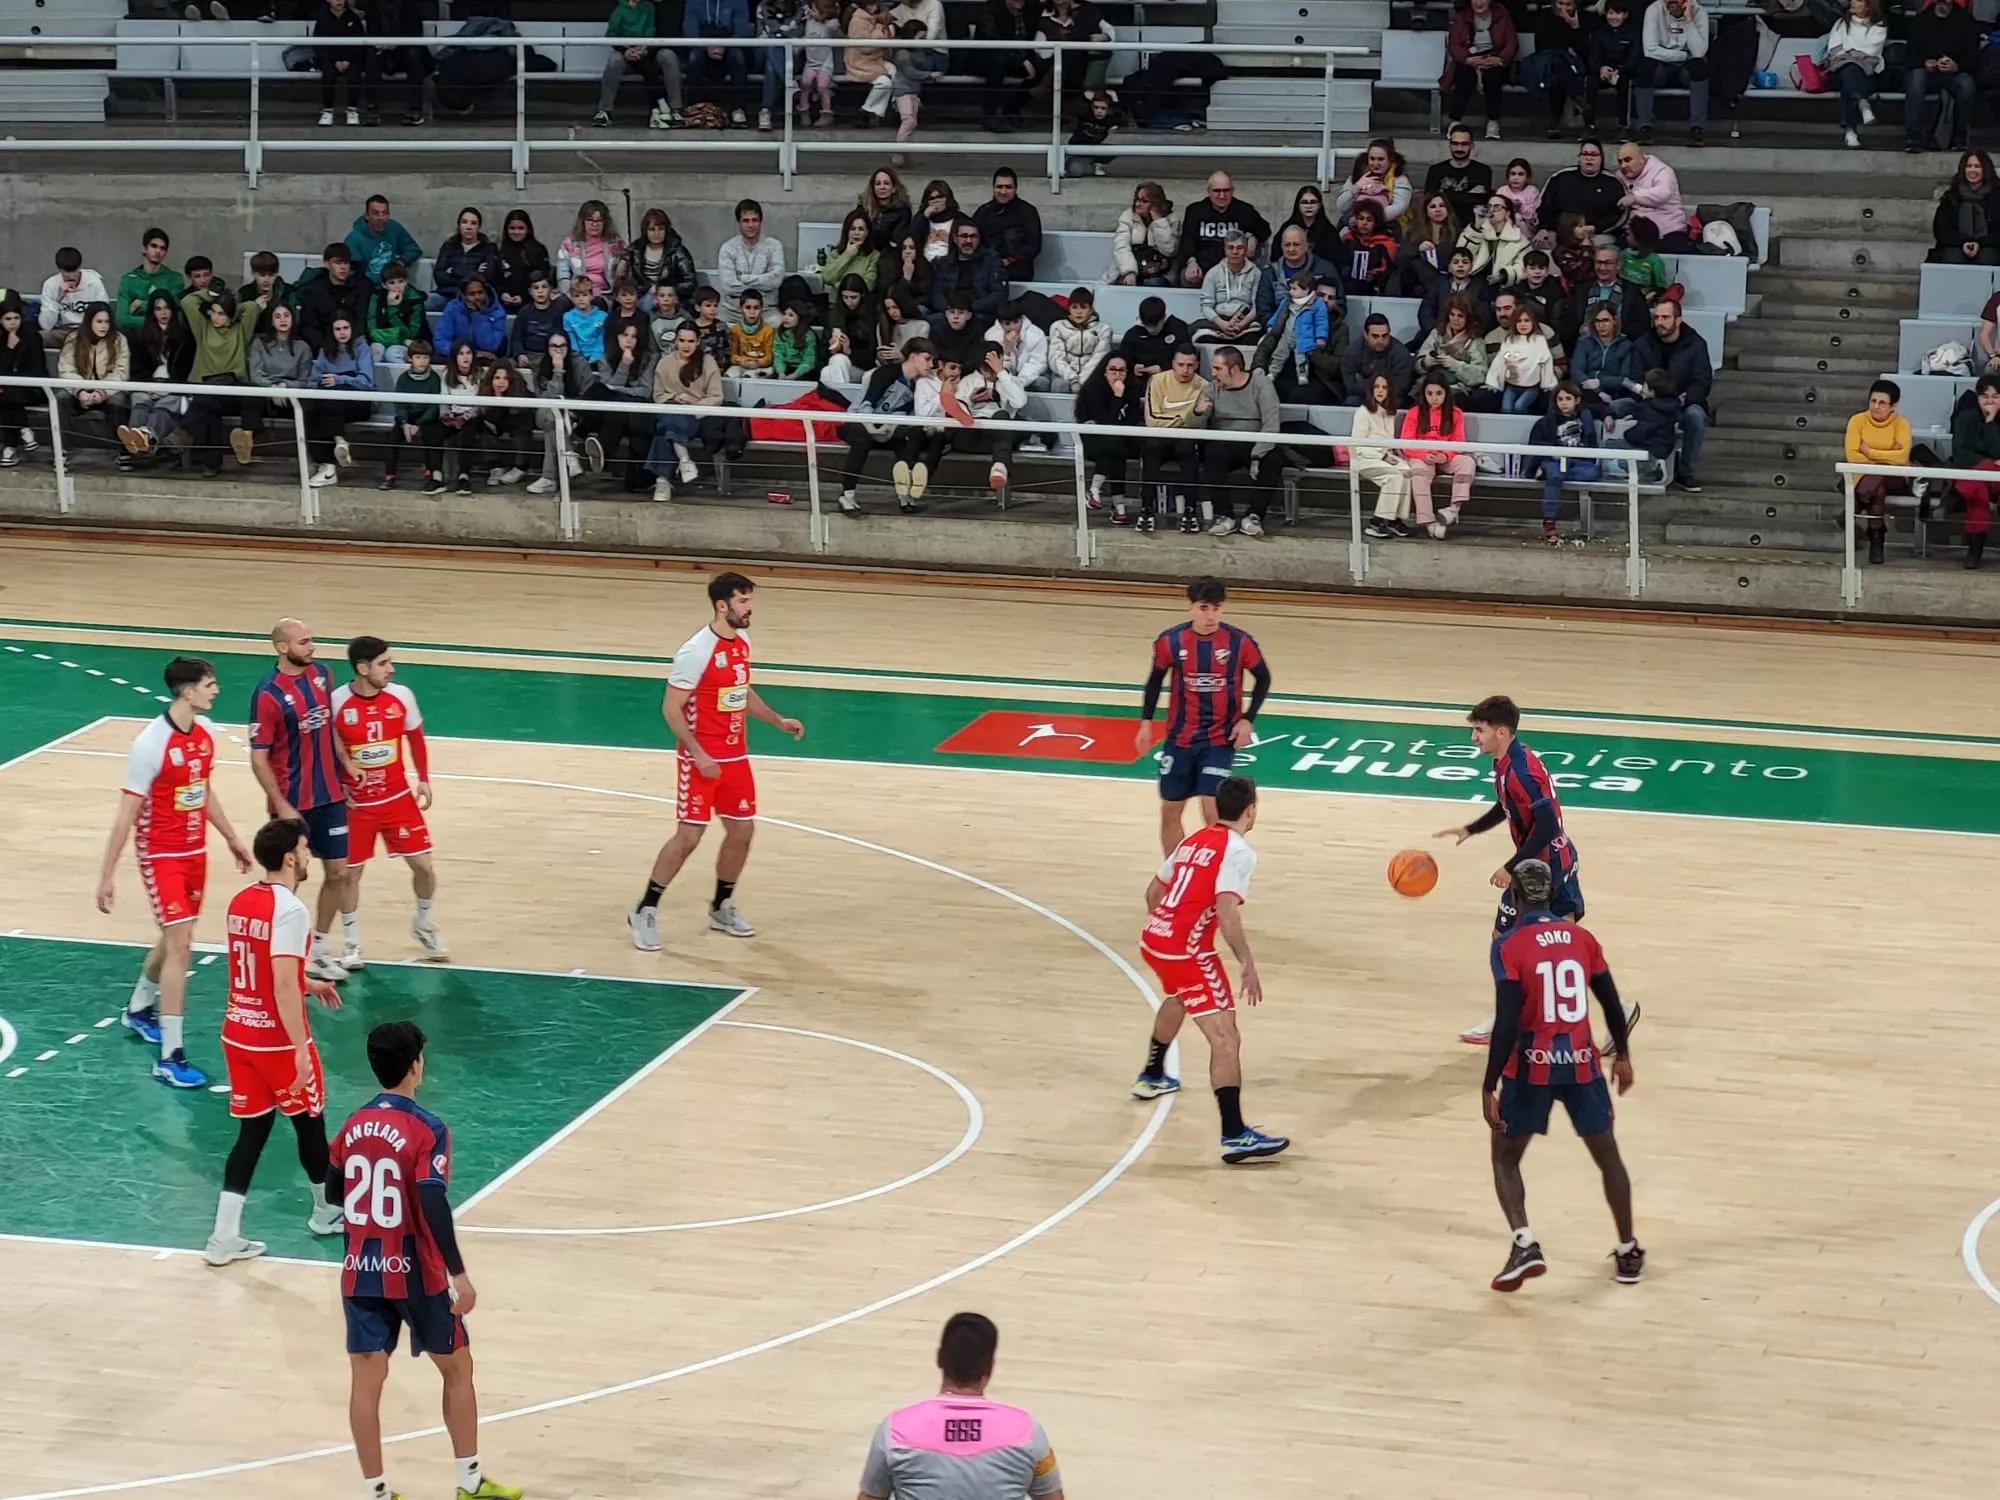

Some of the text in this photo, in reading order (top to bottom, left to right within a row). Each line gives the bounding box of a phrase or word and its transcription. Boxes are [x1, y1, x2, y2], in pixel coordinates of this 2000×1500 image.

[1536, 930, 1571, 947] SOKO
[1535, 959, 1587, 1023] 19
[1525, 1047, 1592, 1065] SOMMOS
[345, 1121, 407, 1153] ANGLADA
[344, 1154, 402, 1229] 26
[344, 1253, 412, 1274] OMMOS
